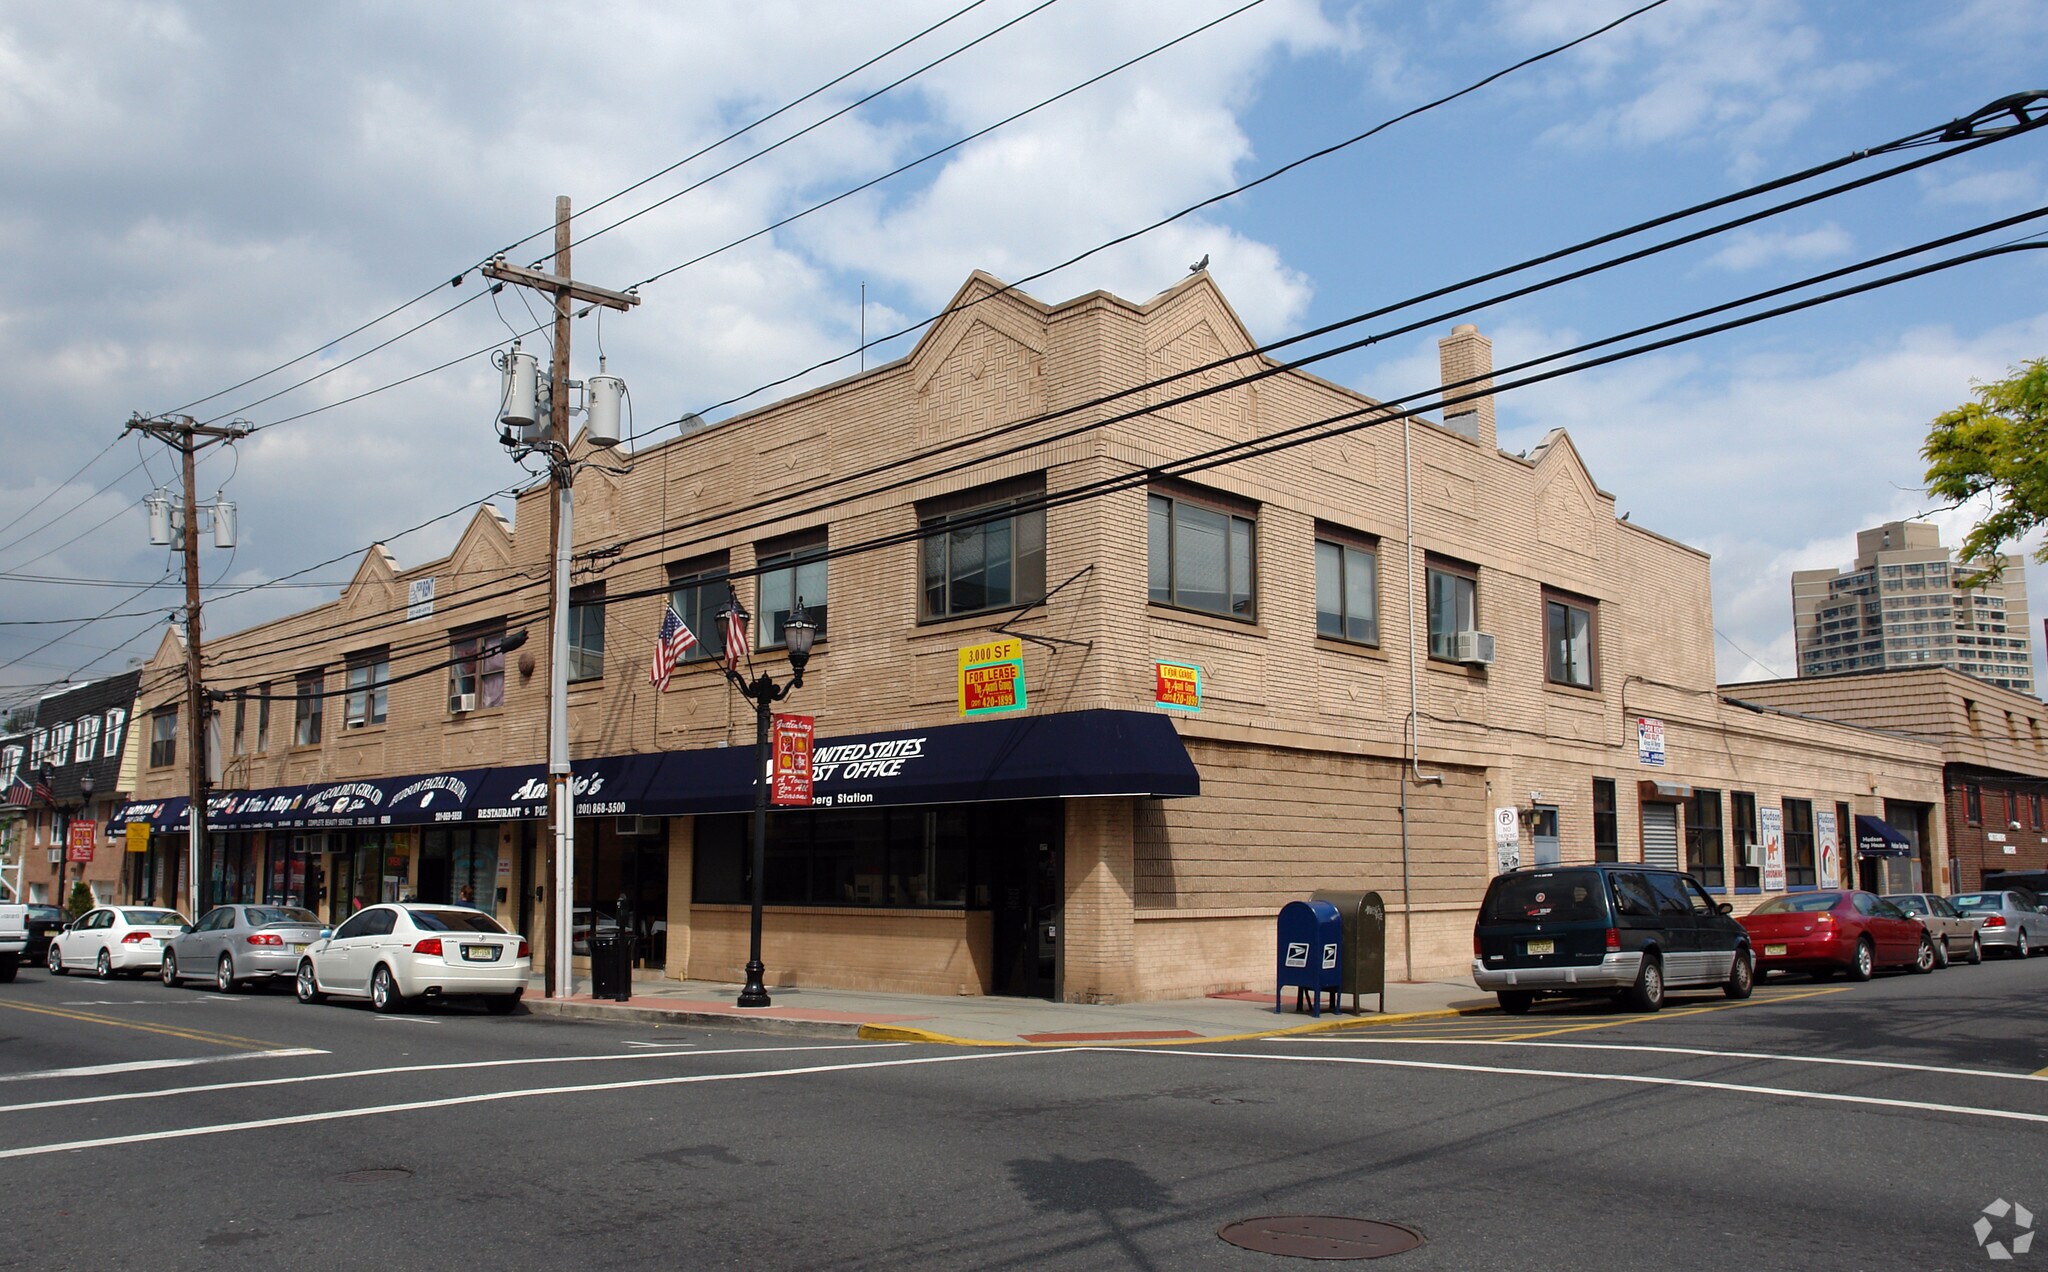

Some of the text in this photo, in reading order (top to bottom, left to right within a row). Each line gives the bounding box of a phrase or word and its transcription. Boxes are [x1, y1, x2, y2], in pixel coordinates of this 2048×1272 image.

[969, 644, 1011, 663] 3,000 SF
[969, 667, 1016, 683] FOR LEASE
[812, 737, 927, 763] UNITED STATES
[776, 775, 809, 784] A Town
[812, 764, 839, 782] OST
[420, 776, 449, 791] FACIAL
[777, 783, 809, 792] For All
[304, 791, 324, 809] THE
[322, 783, 358, 800] GOLDEN
[355, 783, 374, 799] GIRL
[777, 790, 808, 800] Seasons
[837, 793, 874, 804] Station
[270, 795, 293, 814] Shop
[477, 807, 522, 818] RESTAURANT
[575, 803, 591, 815] (201)
